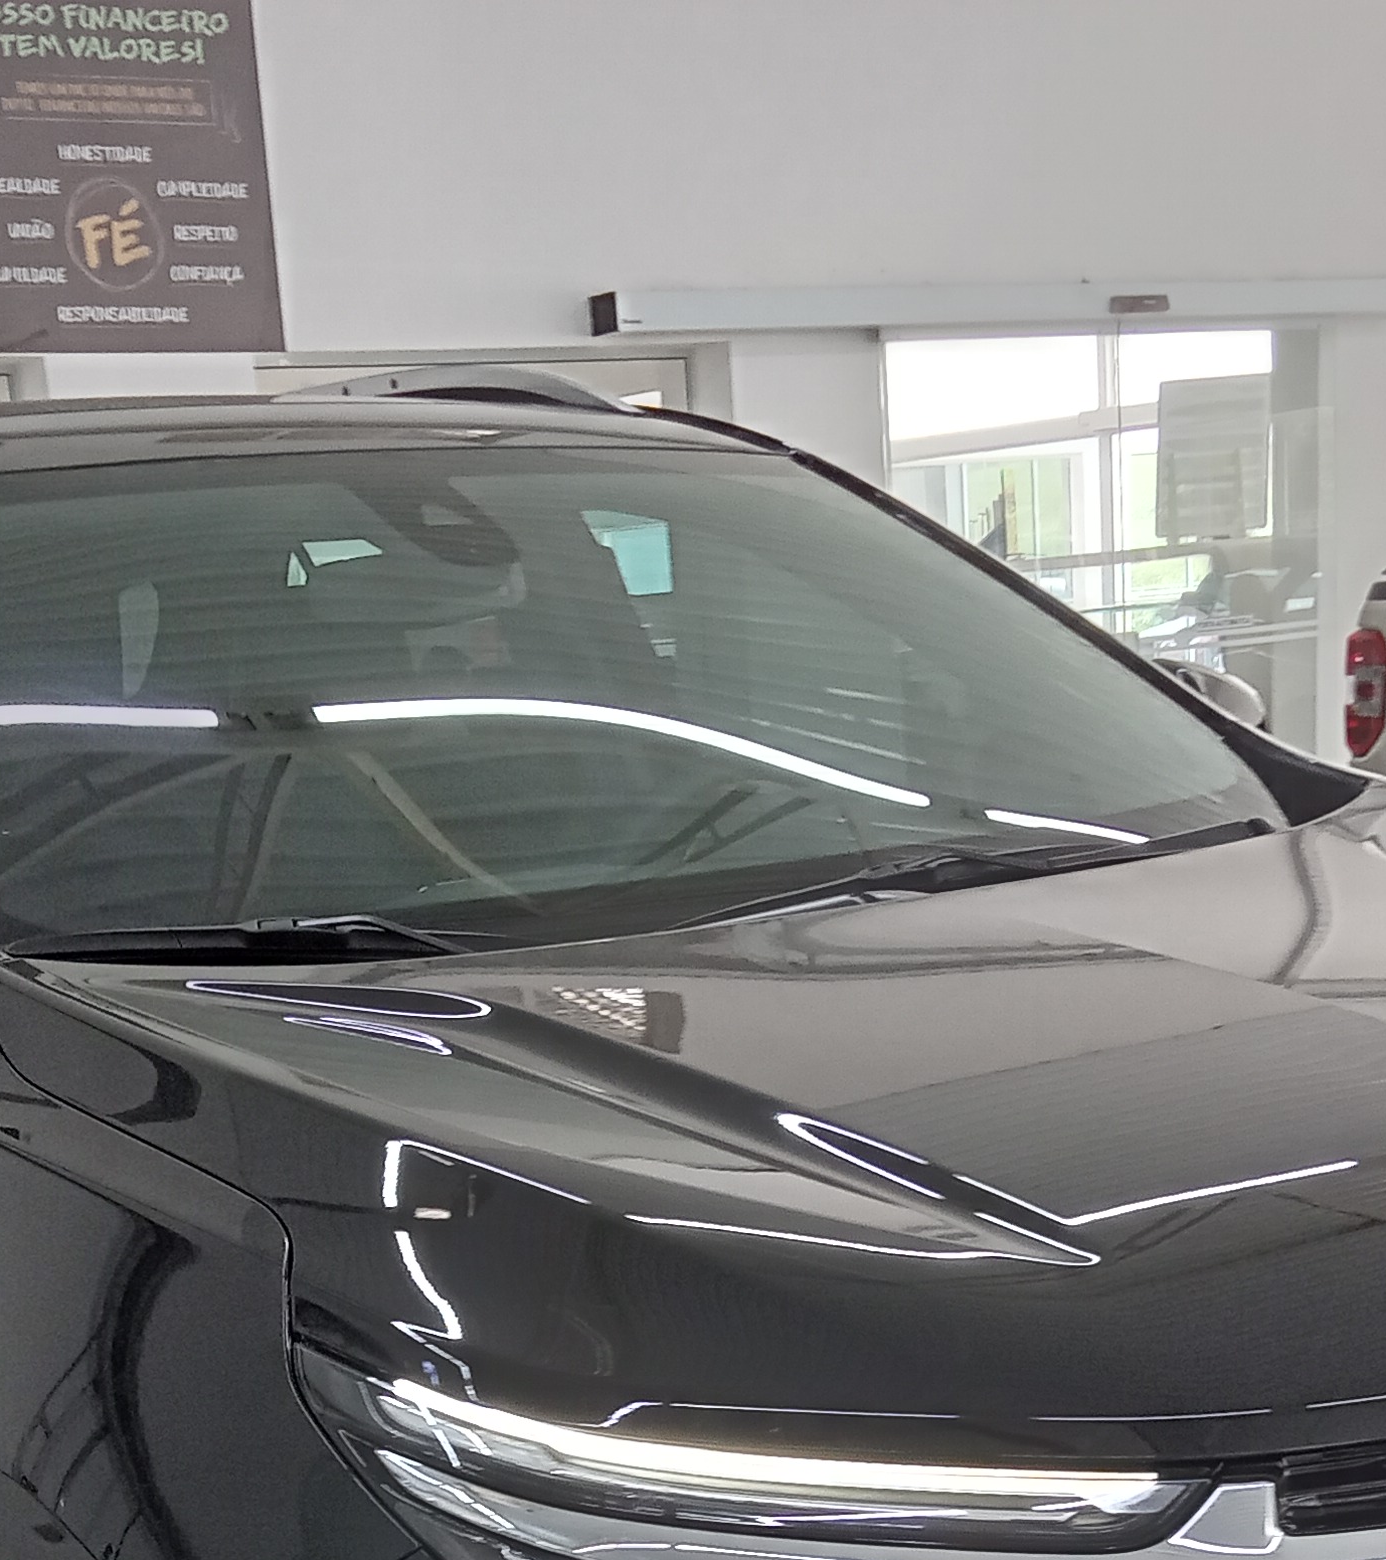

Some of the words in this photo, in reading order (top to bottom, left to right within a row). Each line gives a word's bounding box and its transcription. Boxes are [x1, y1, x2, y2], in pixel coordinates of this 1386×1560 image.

[61, 4, 230, 36] FINANCEIRO
[67, 36, 206, 65] VALORES!
[57, 144, 153, 163] HONESTIDADE
[7, 218, 56, 240] UNIÃO
[77, 198, 153, 269] FÉ
[173, 224, 240, 242] RESPEITO
[169, 265, 245, 287] CONFIANÇA
[57, 306, 191, 322] RESPONSABILIDADE
